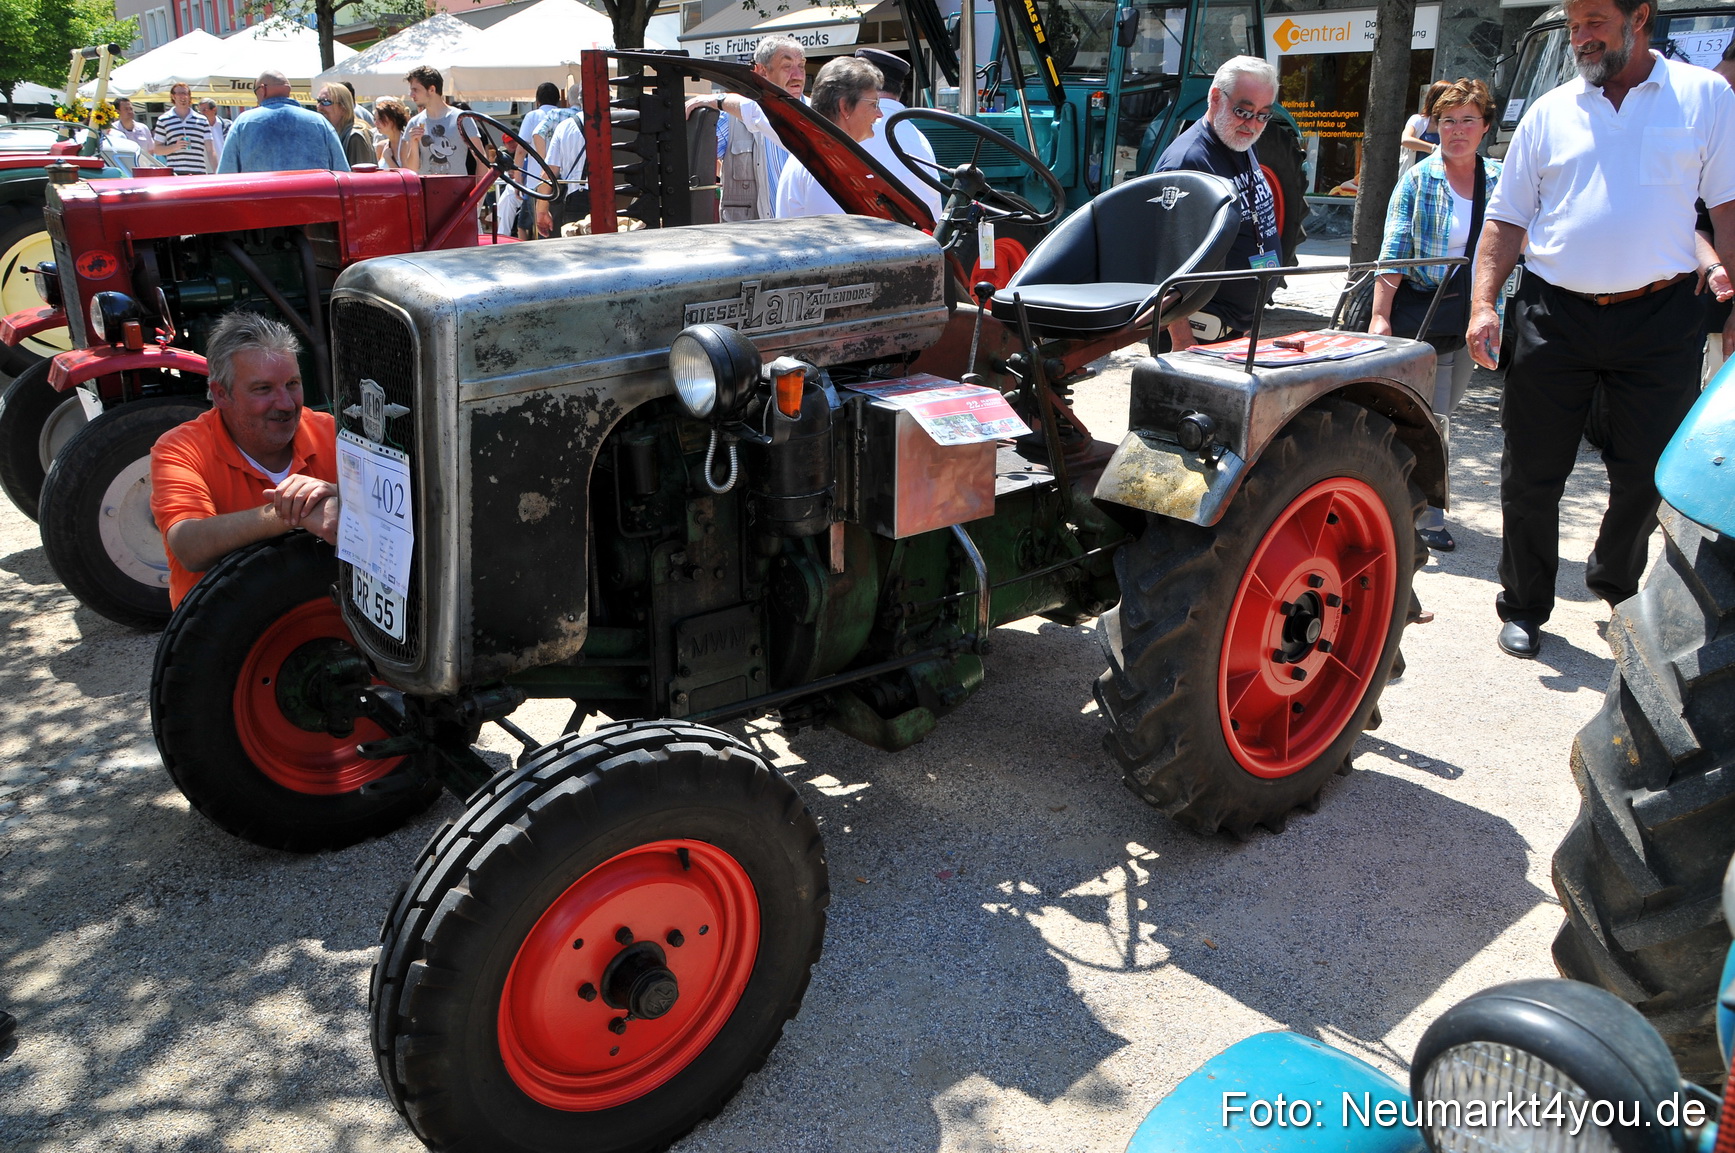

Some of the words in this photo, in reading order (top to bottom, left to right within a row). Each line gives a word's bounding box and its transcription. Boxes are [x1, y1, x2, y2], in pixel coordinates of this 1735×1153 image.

[1287, 22, 1351, 45] Central
[704, 41, 720, 55] Eis
[1697, 39, 1723, 52] 153
[1281, 100, 1309, 108] Wellness
[1310, 100, 1316, 108] &
[1289, 110, 1359, 119] metikbehandlungen
[1337, 121, 1347, 129] up
[689, 303, 747, 324] DIESEL
[811, 288, 872, 306] AULENDORF
[371, 474, 405, 519] 402
[357, 574, 369, 613] PR
[375, 591, 394, 630] 55
[690, 626, 746, 659] MWM
